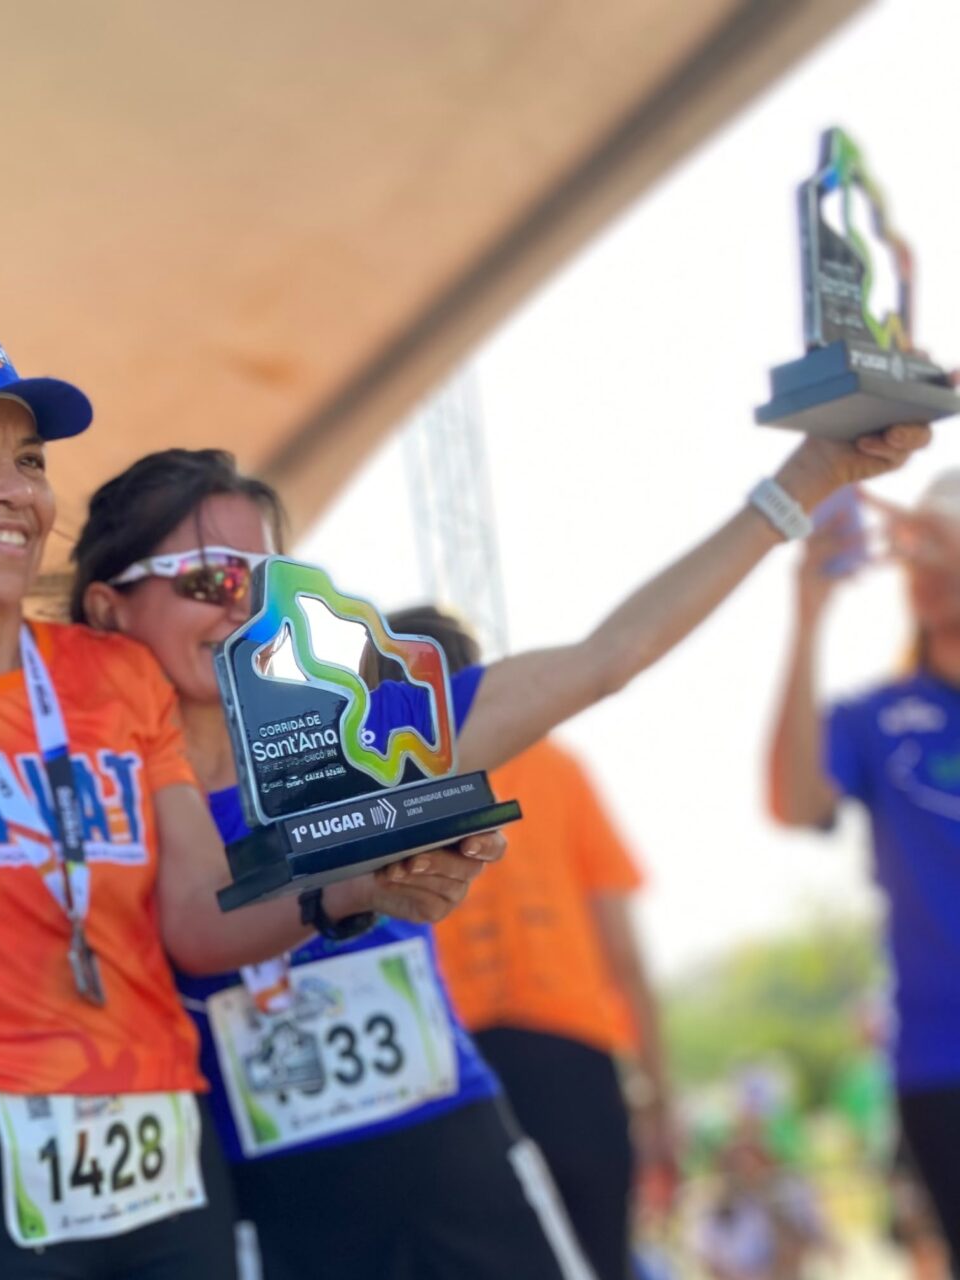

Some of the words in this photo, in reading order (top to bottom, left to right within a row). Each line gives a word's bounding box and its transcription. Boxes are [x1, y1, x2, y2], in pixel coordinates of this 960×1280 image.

[259, 718, 305, 737] CORRIDA
[306, 714, 321, 726] DE
[252, 729, 339, 761] Sant'Ana
[310, 812, 366, 839] LUGAR
[39, 1114, 164, 1203] 1428
